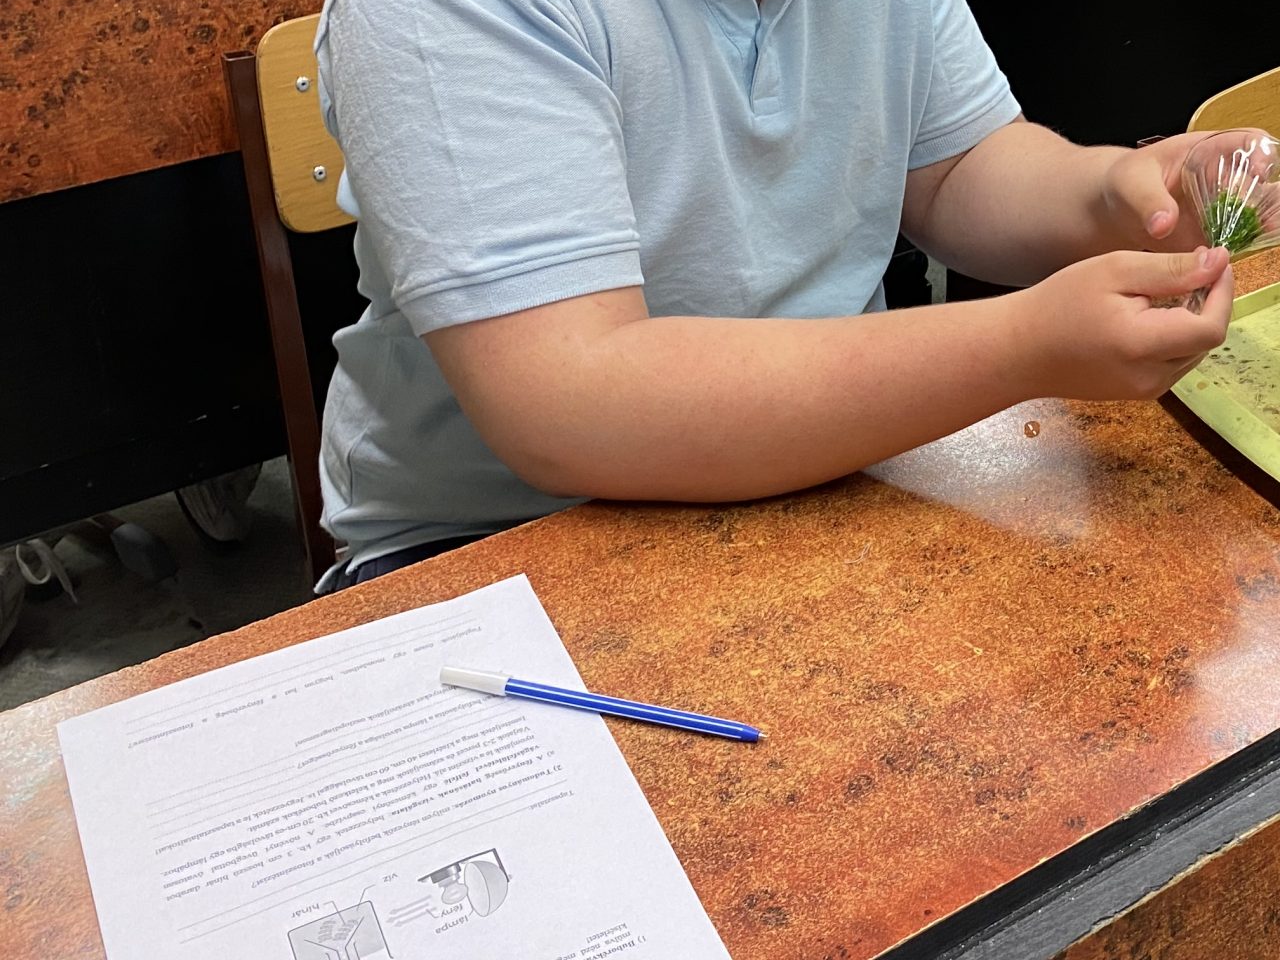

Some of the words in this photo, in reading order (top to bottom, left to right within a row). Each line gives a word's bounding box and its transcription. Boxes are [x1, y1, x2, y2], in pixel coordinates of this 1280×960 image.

[405, 755, 418, 763] 40
[364, 769, 377, 777] cm
[378, 765, 390, 774] 60
[421, 781, 438, 791] egy
[496, 767, 551, 792] Tudományos
[437, 777, 482, 798] hatásának
[420, 805, 451, 822] milyen
[301, 816, 314, 826] 20
[314, 833, 331, 845] egy
[322, 831, 381, 859] befolyásolják
[207, 848, 225, 859] egy
[267, 854, 282, 862] cm
[249, 858, 315, 888] fotoszintézist?
[381, 872, 398, 883] víz
[204, 874, 229, 888] hínár
[165, 884, 201, 903] darabot
[290, 902, 319, 919] hínár
[439, 902, 463, 917] fény
[433, 914, 469, 934] lámpa
